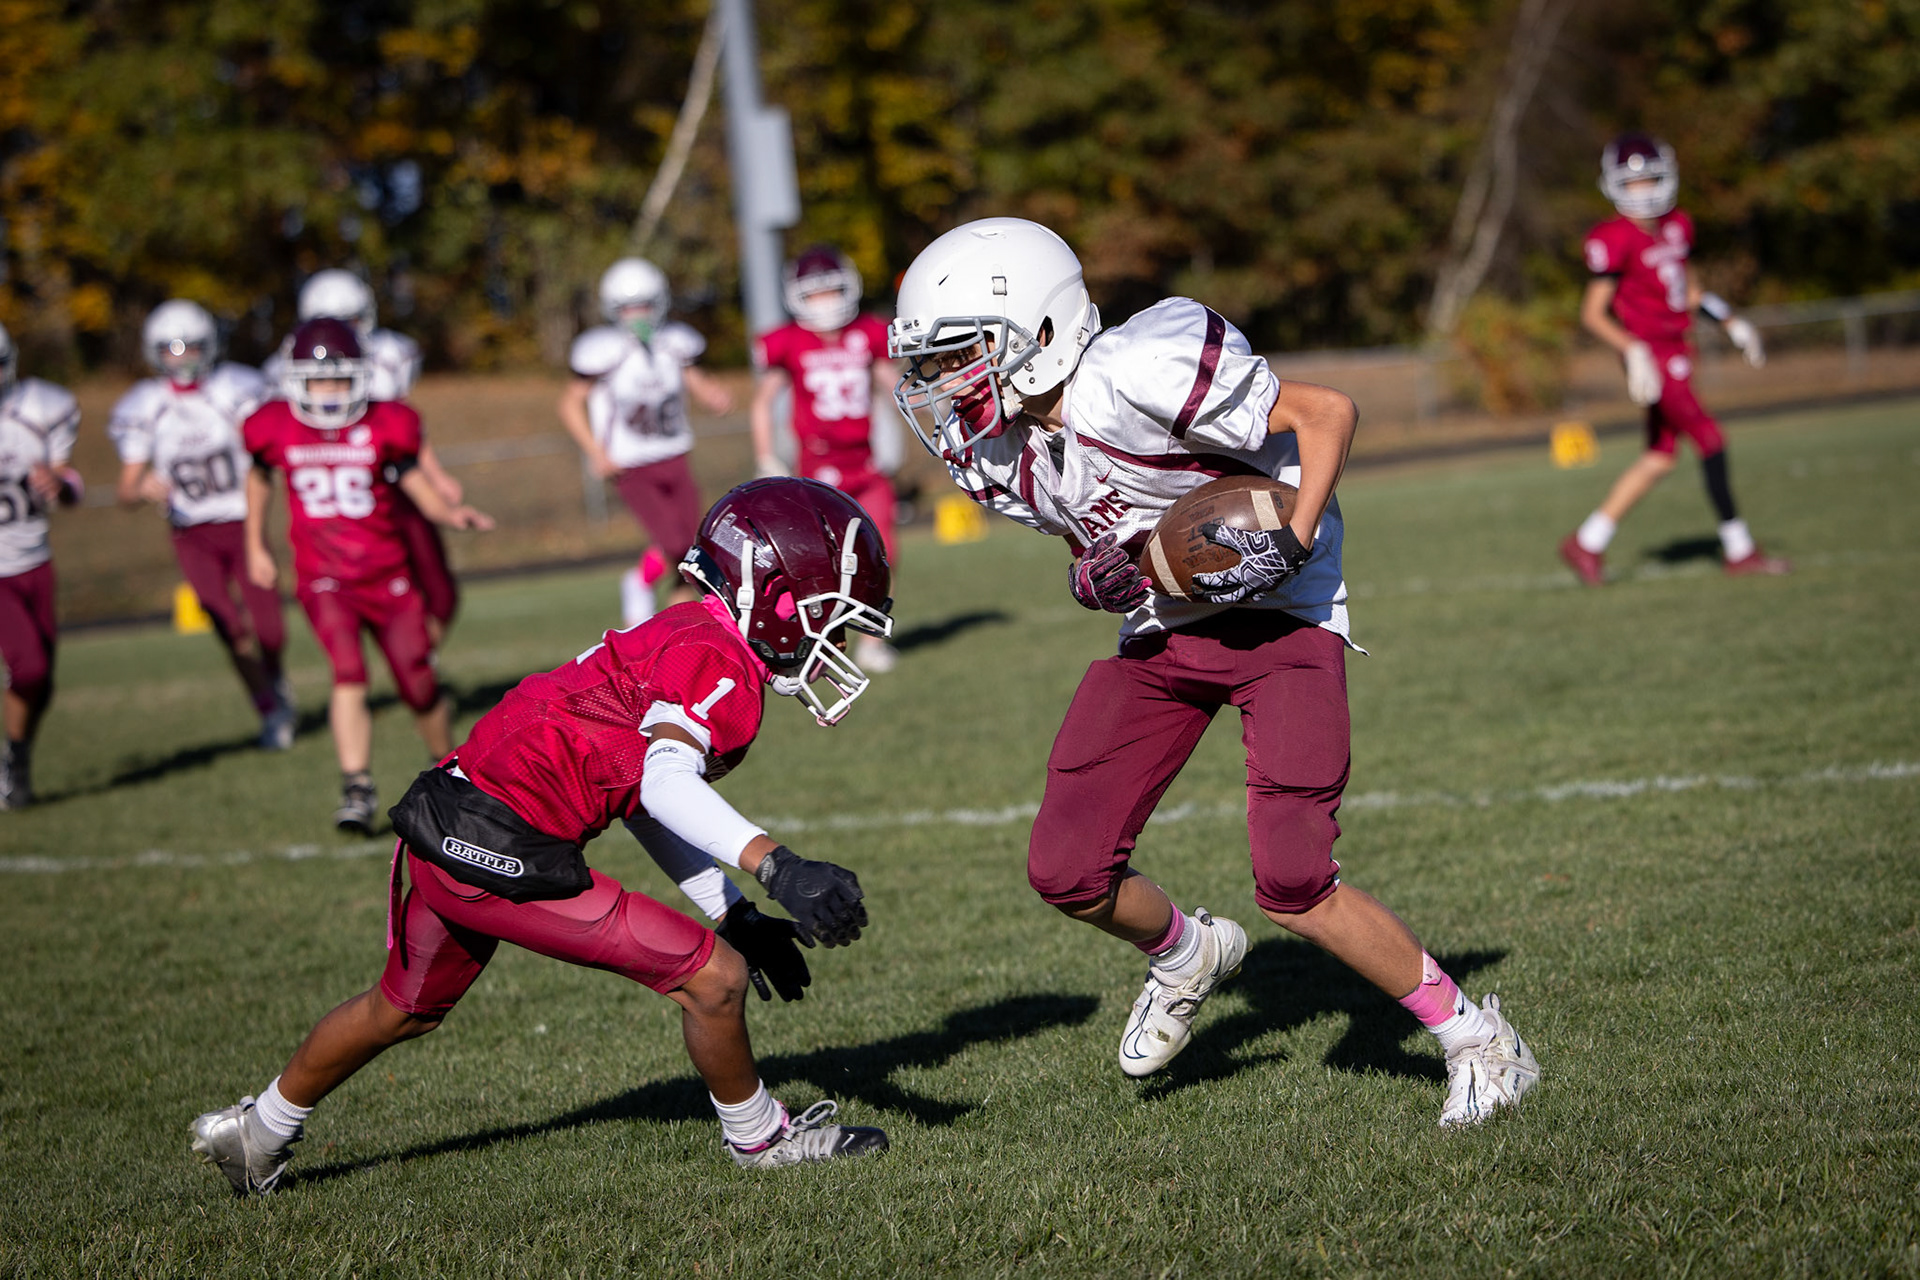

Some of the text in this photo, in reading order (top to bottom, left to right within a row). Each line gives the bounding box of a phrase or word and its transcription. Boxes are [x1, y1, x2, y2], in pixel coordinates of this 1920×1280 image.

[170, 450, 238, 502] 60
[292, 467, 376, 519] 26
[690, 677, 736, 720] 1
[447, 841, 517, 873] BATTLE
